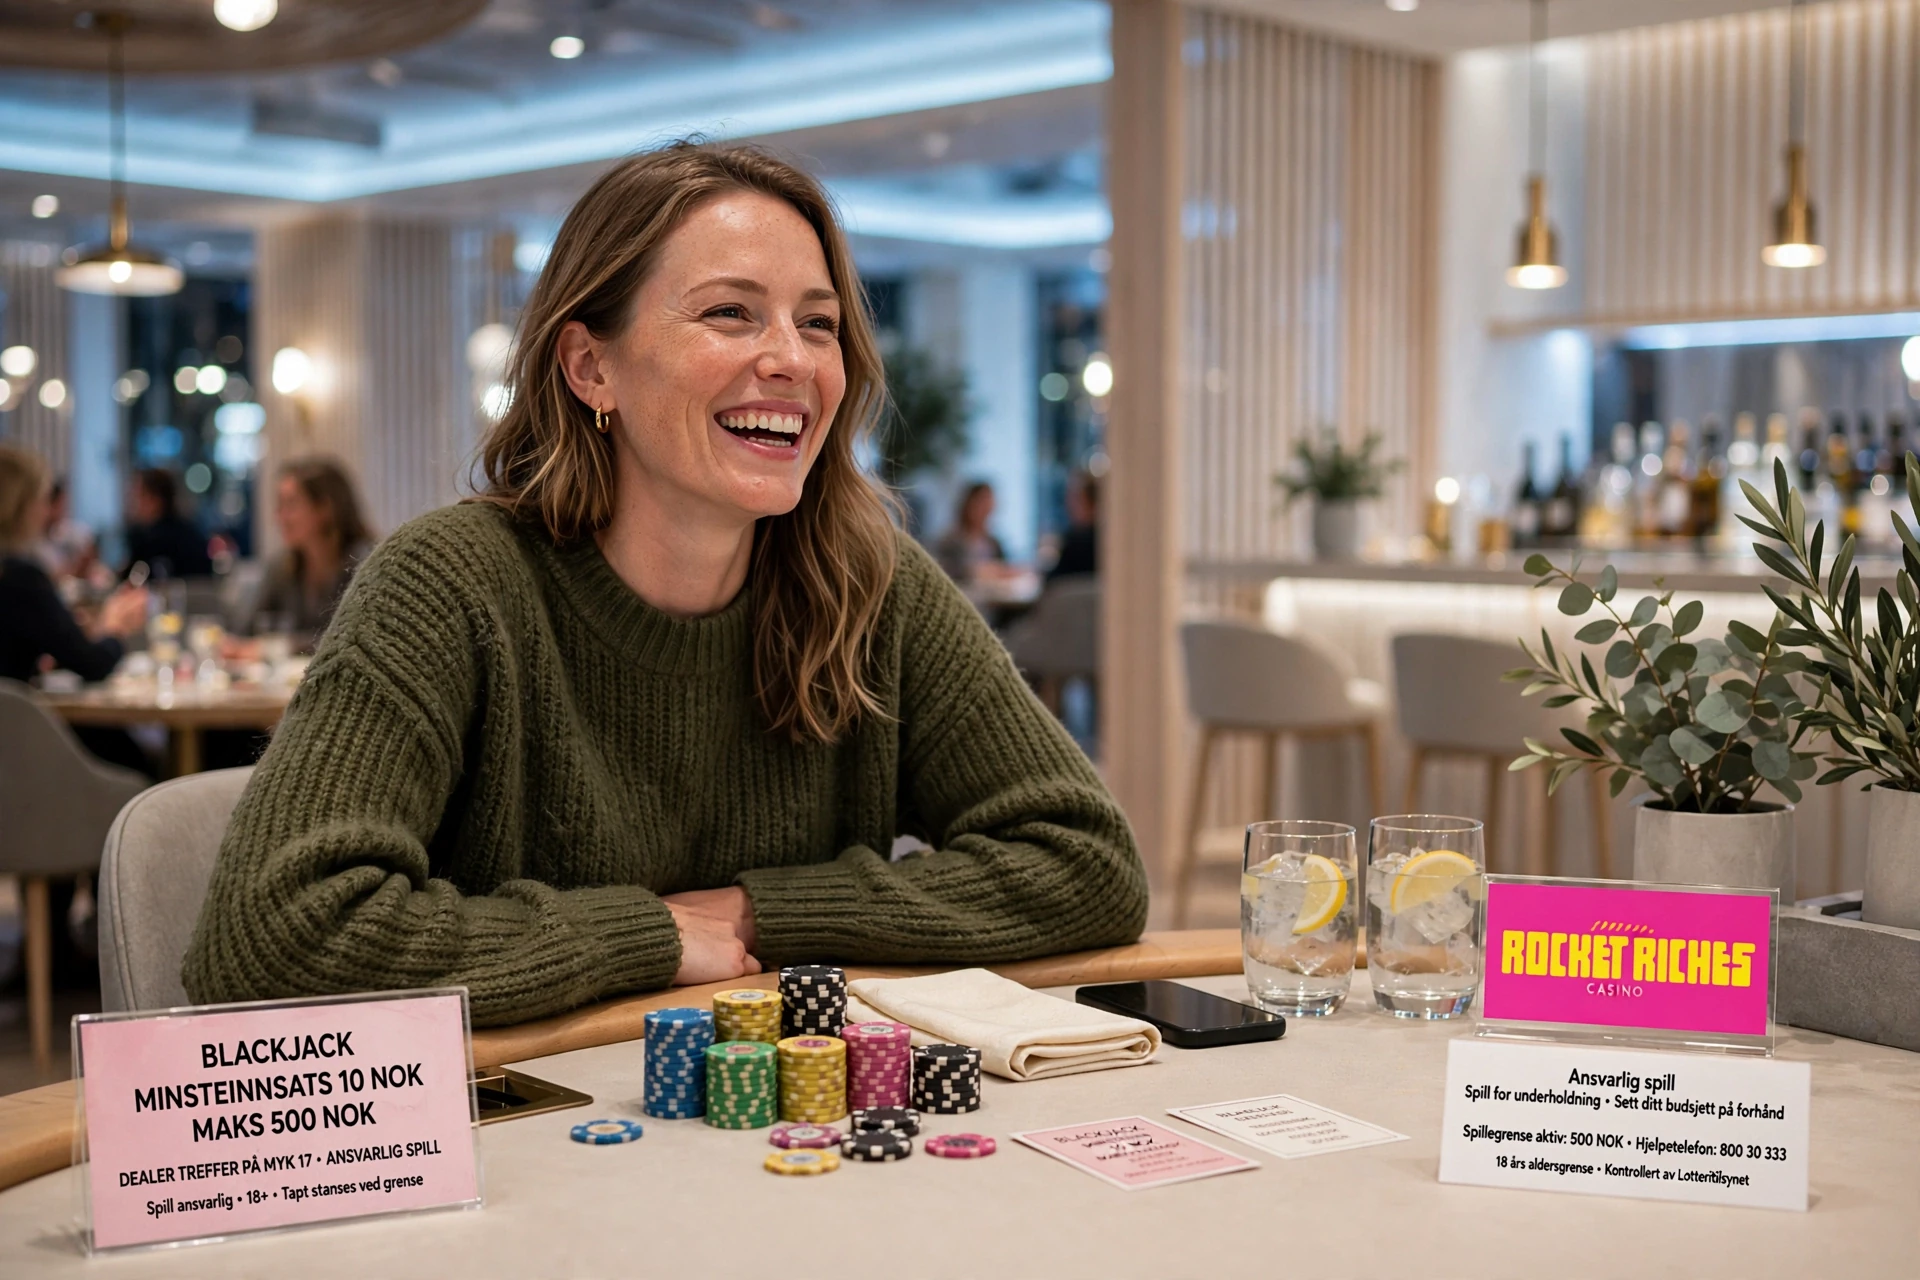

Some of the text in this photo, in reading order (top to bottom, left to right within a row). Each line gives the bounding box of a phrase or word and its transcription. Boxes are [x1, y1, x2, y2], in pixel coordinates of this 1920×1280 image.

[1502, 930, 1755, 987] ROCKET RICHES
[1587, 983, 1642, 996] CASINO
[202, 1032, 354, 1068] BLACKJACK
[135, 1063, 424, 1112] MINSTEINNSATS 10 NOK
[1568, 1068, 1675, 1095] Ansvarlig spill
[1465, 1085, 1784, 1119] Spill for underholdning Sett ditt budsjett på forhånd
[193, 1102, 376, 1142] MAKS 500 NOK
[1463, 1124, 1786, 1161] Spillegrense aktiv: 500 NOK Hjelpetelefon: 800 30 333
[120, 1140, 441, 1187] DEALER TREFFER PÅ MYK 17 ANSVARLIG SPILL
[1496, 1156, 1507, 1167] 18
[1510, 1156, 1525, 1169] års
[1529, 1158, 1593, 1175] aldersgrense
[1605, 1163, 1660, 1179] Kontrollert
[1663, 1171, 1675, 1181] av
[147, 1176, 423, 1219] Spill ansvarlig 18+ Tapt stanses ved grense
